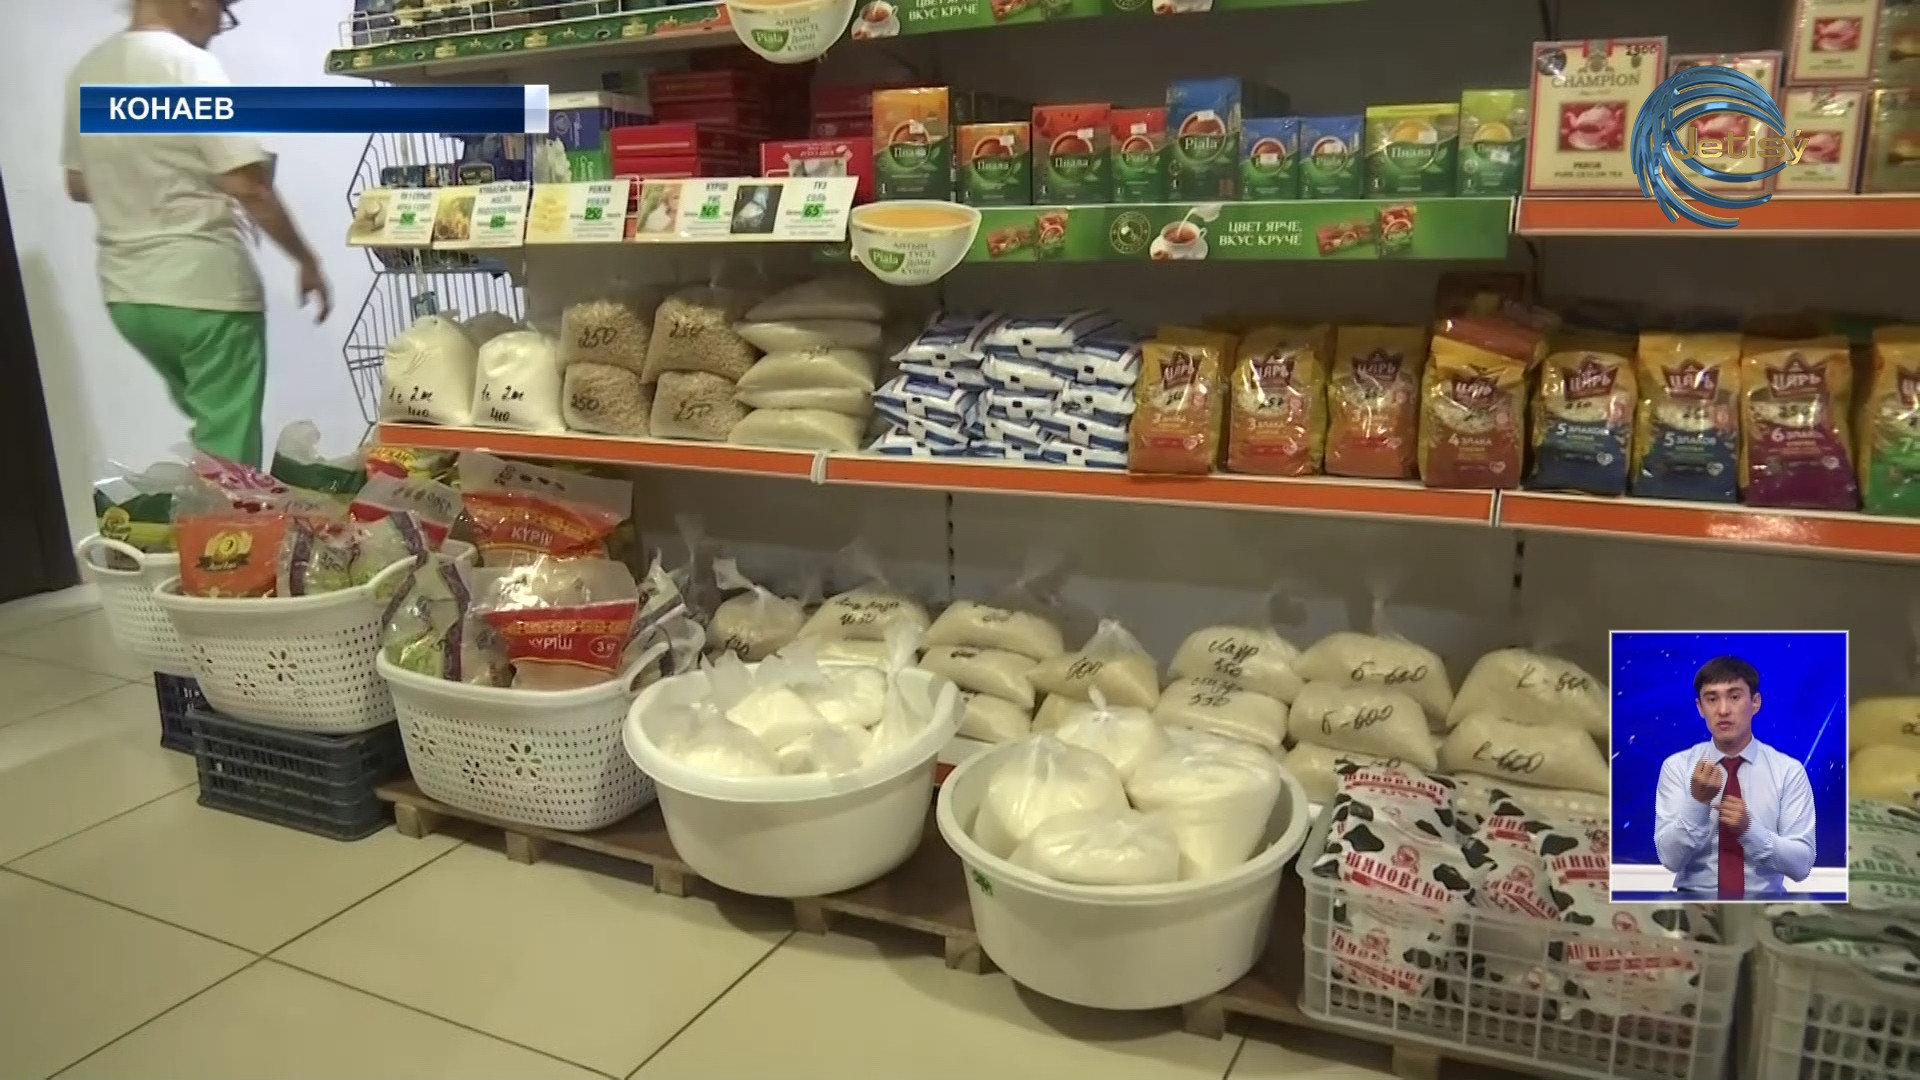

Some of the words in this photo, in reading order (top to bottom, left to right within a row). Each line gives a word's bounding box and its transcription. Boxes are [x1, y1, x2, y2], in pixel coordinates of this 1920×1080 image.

[909, 7, 938, 21] ВКУС
[941, 3, 978, 17] КРУЧЕ
[1551, 73, 1640, 89] CHAMPION
[1184, 136, 1219, 150] Piala
[977, 160, 1009, 171] Пиала
[1055, 157, 1090, 169] Пиала
[803, 203, 825, 218] 65
[1228, 220, 1262, 234] ЦВЕТ
[1219, 235, 1254, 246] ВКУС
[1257, 235, 1302, 246] КРУЧЕ
[578, 326, 617, 349] 250
[1771, 372, 1821, 391] ЦАРЬ
[1555, 422, 1568, 437] 5
[1771, 427, 1785, 442] 6
[1448, 432, 1460, 447] 4
[1663, 430, 1676, 447] 5
[597, 640, 605, 653] 3
